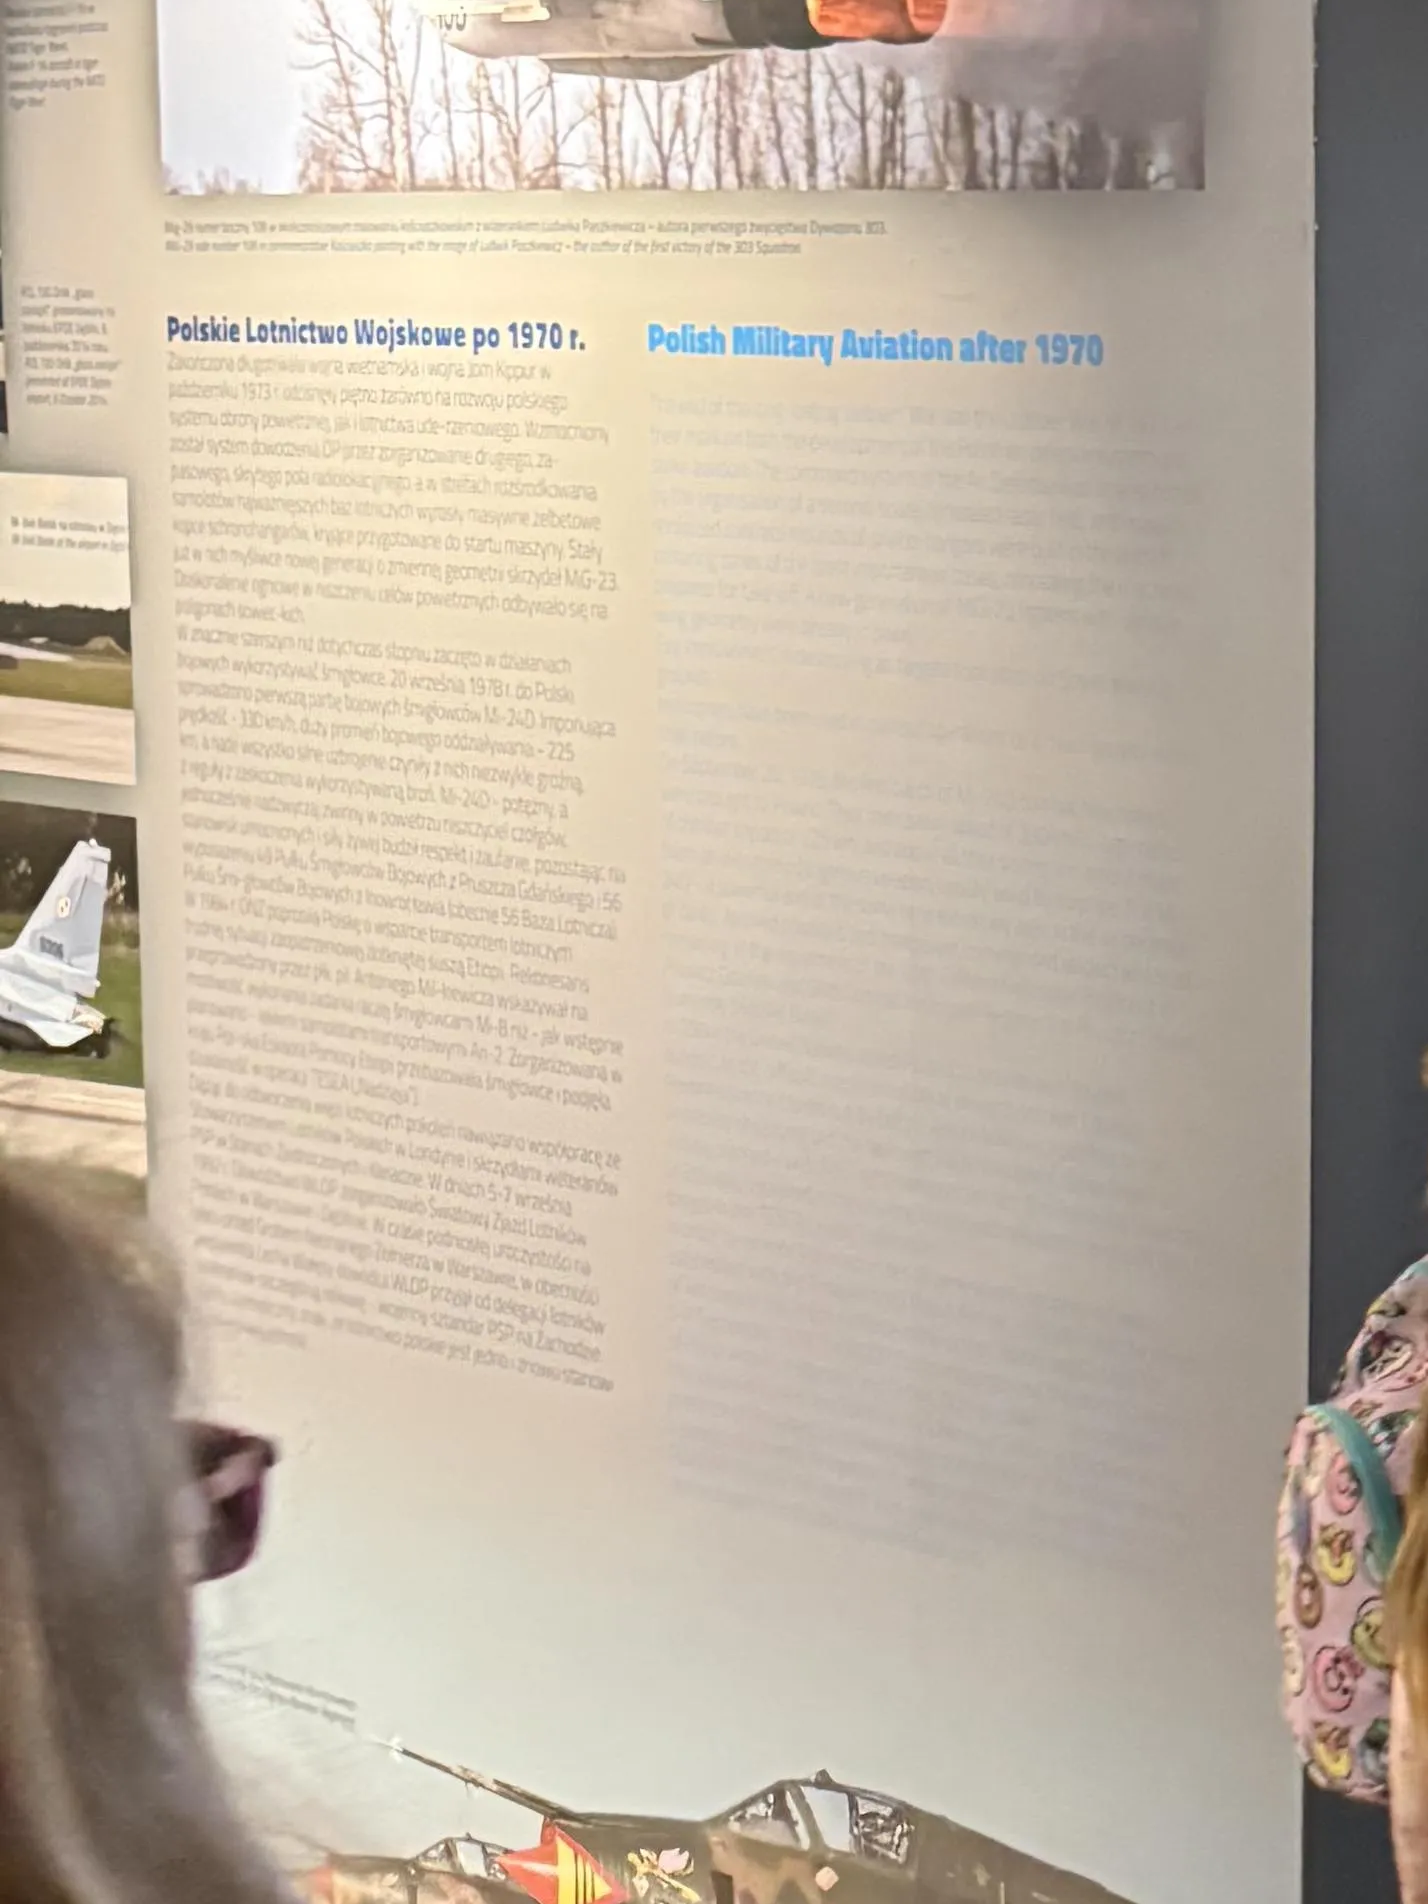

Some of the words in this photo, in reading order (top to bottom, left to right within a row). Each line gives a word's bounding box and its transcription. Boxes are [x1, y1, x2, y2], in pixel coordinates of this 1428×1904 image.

[167, 315, 240, 344] Polskie
[246, 316, 348, 345] Lotnictwo
[354, 318, 467, 353] Wojskowe
[473, 326, 500, 355] po
[507, 322, 563, 350] 1970
[569, 329, 586, 351] r.
[648, 323, 726, 355] Polish
[732, 325, 835, 367] Military
[840, 329, 954, 361] Aviation
[959, 330, 1027, 364] after
[1035, 333, 1105, 367] 1970
